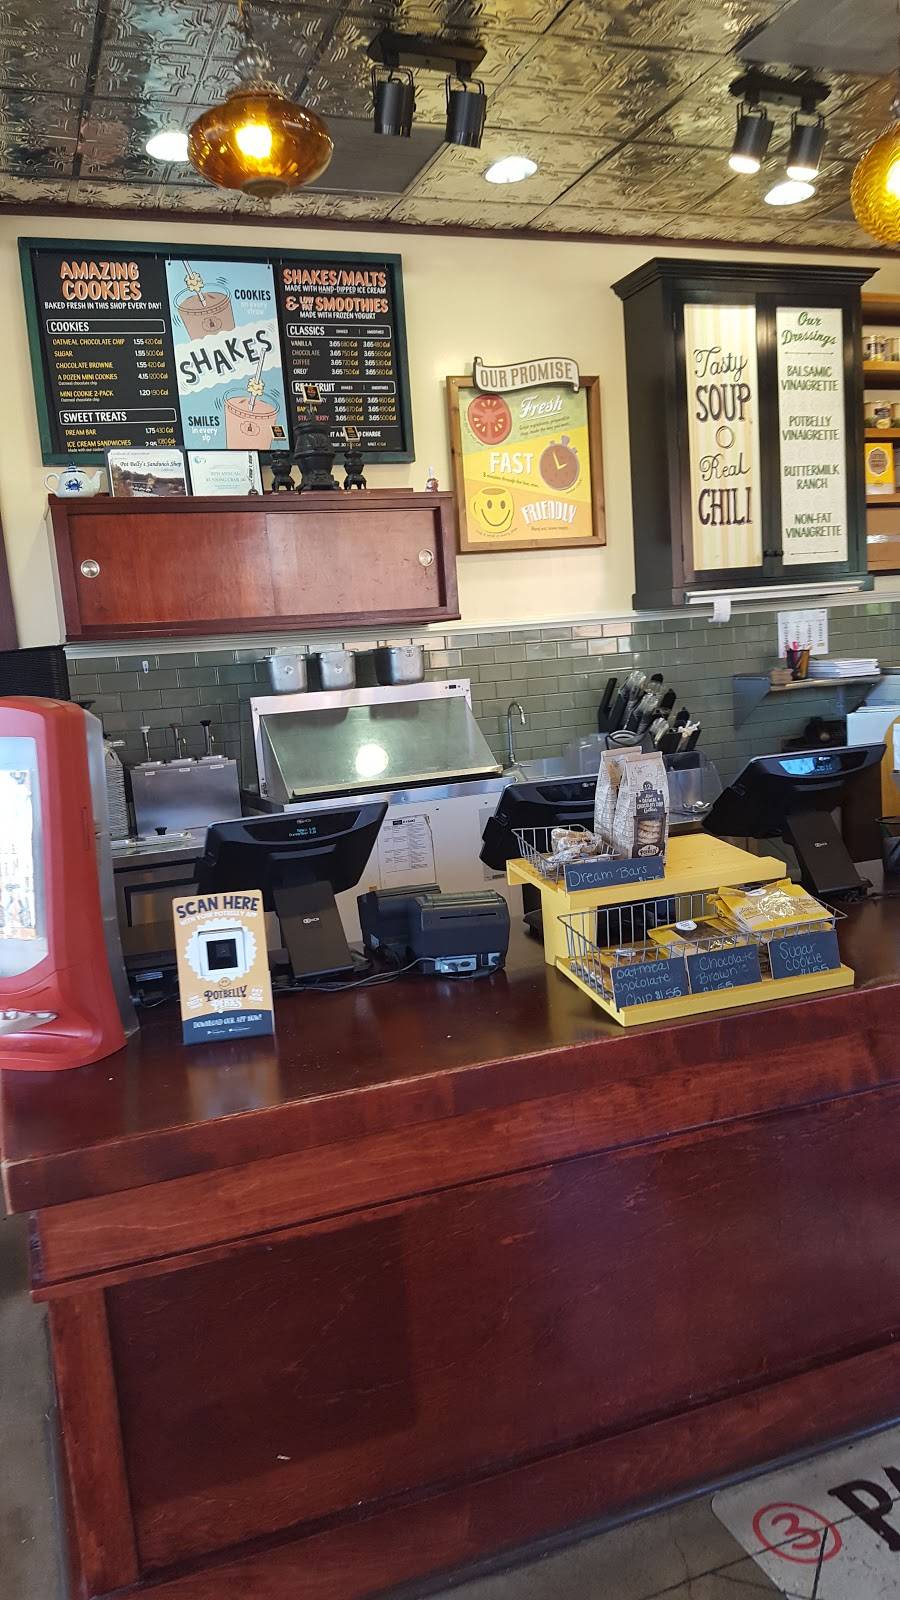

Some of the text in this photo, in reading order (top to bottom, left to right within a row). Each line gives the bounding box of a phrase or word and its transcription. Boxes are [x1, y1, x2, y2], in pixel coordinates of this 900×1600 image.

[60, 261, 139, 280] AMAZING
[283, 268, 386, 288] SHAKES/MALTS
[62, 280, 142, 300] COOKIES
[234, 289, 271, 300] COOKIES
[318, 286, 356, 294] HAND-DIPPED
[44, 302, 162, 310] BAKED FRESH IN THIS SHOP EVERY DAY!
[286, 296, 300, 311] &
[315, 296, 388, 313] SMOOTHIES
[354, 312, 376, 320] YOGURT
[798, 312, 822, 326] Our
[50, 322, 90, 332] COOKIES
[290, 326, 325, 336] CLASSICS
[781, 330, 838, 346] Dressings
[180, 330, 272, 384] SHAKES
[694, 346, 748, 382] Tasty
[480, 362, 573, 388] OUR PROMISE
[786, 366, 832, 378] BALSAMIC
[74, 390, 94, 398] COOKIE
[782, 380, 839, 392] VINAIGRETTE
[520, 395, 564, 418] Fresh
[696, 382, 752, 422] SOUP
[63, 412, 128, 423] SWEET TREATS
[188, 416, 220, 426] SMILES
[788, 416, 832, 427] POTBELLY
[86, 428, 97, 436] BAR
[782, 428, 840, 441] VINAIGRETTE
[490, 452, 534, 474] FAST
[700, 452, 751, 482] Real
[784, 464, 840, 477] BUTTERMILK
[796, 478, 828, 490] RANCH
[522, 500, 577, 524] FRIENDLY
[698, 486, 753, 526] CHILI
[794, 512, 832, 524] NON-FAT
[786, 526, 842, 538] VINAIGRETTE
[568, 870, 614, 887] Dream
[616, 865, 648, 879] Bars
[176, 896, 260, 918] SCAN HERE
[780, 942, 817, 960] Sugar
[700, 952, 756, 971] Chocolate
[204, 984, 248, 1002] POTBELLY
[772, 1513, 821, 1550] 3
